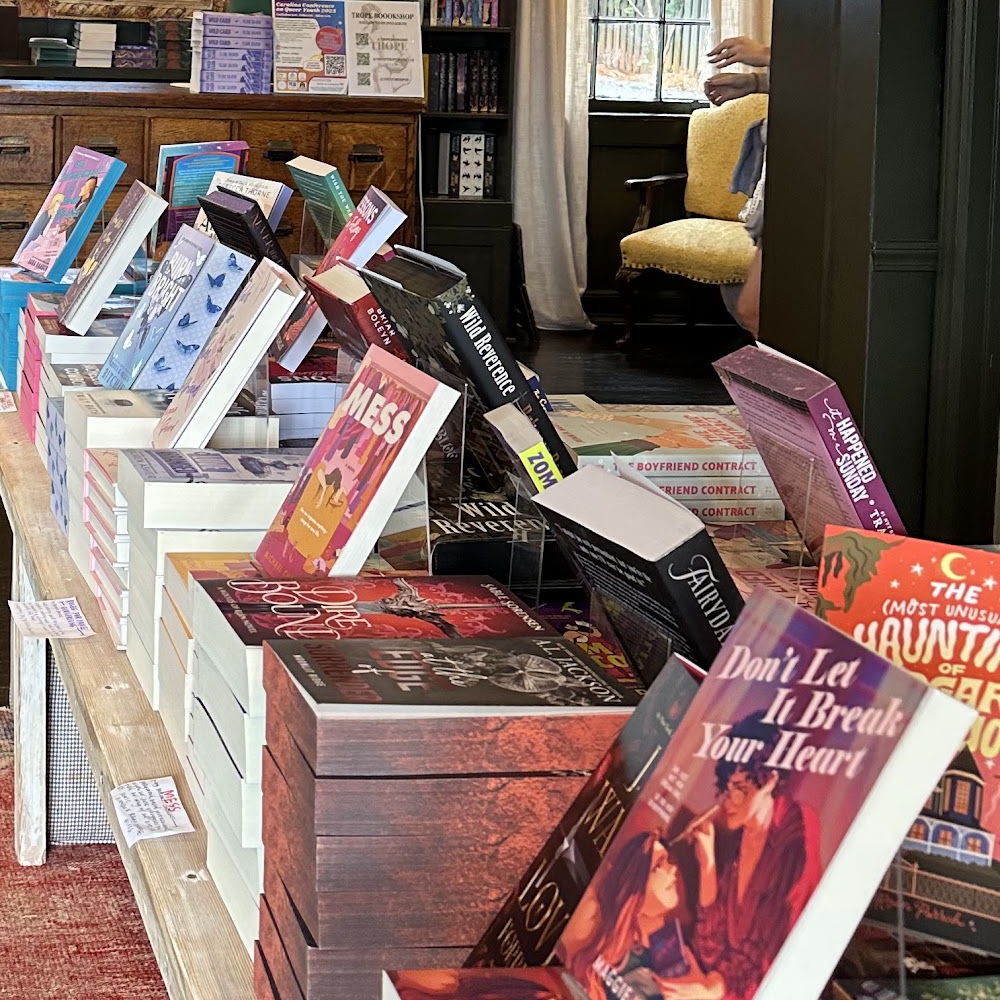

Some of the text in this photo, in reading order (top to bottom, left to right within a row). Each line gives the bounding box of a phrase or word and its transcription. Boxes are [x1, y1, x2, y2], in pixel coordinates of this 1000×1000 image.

[244, 187, 271, 199] THORNE
[366, 307, 391, 345] BOLEYN
[459, 304, 516, 397] Wild Reverence
[342, 381, 412, 445] MESS
[637, 461, 699, 472] BOYFRIEND
[702, 461, 758, 472] CONTRACT
[836, 417, 877, 484] HAPPENED
[701, 485, 757, 495] CONTRACT
[835, 452, 870, 503] SUNDAY
[451, 501, 517, 518] Wild
[701, 507, 757, 517] CONTRACT
[882, 598, 941, 617] (MOST
[930, 581, 982, 604] THE
[501, 600, 546, 632] SORENSEN
[555, 657, 622, 704] JACKSON
[717, 644, 862, 688] Don't Let
[938, 662, 967, 675] OF
[761, 687, 905, 737] It Break
[693, 721, 869, 779] Your Heart
